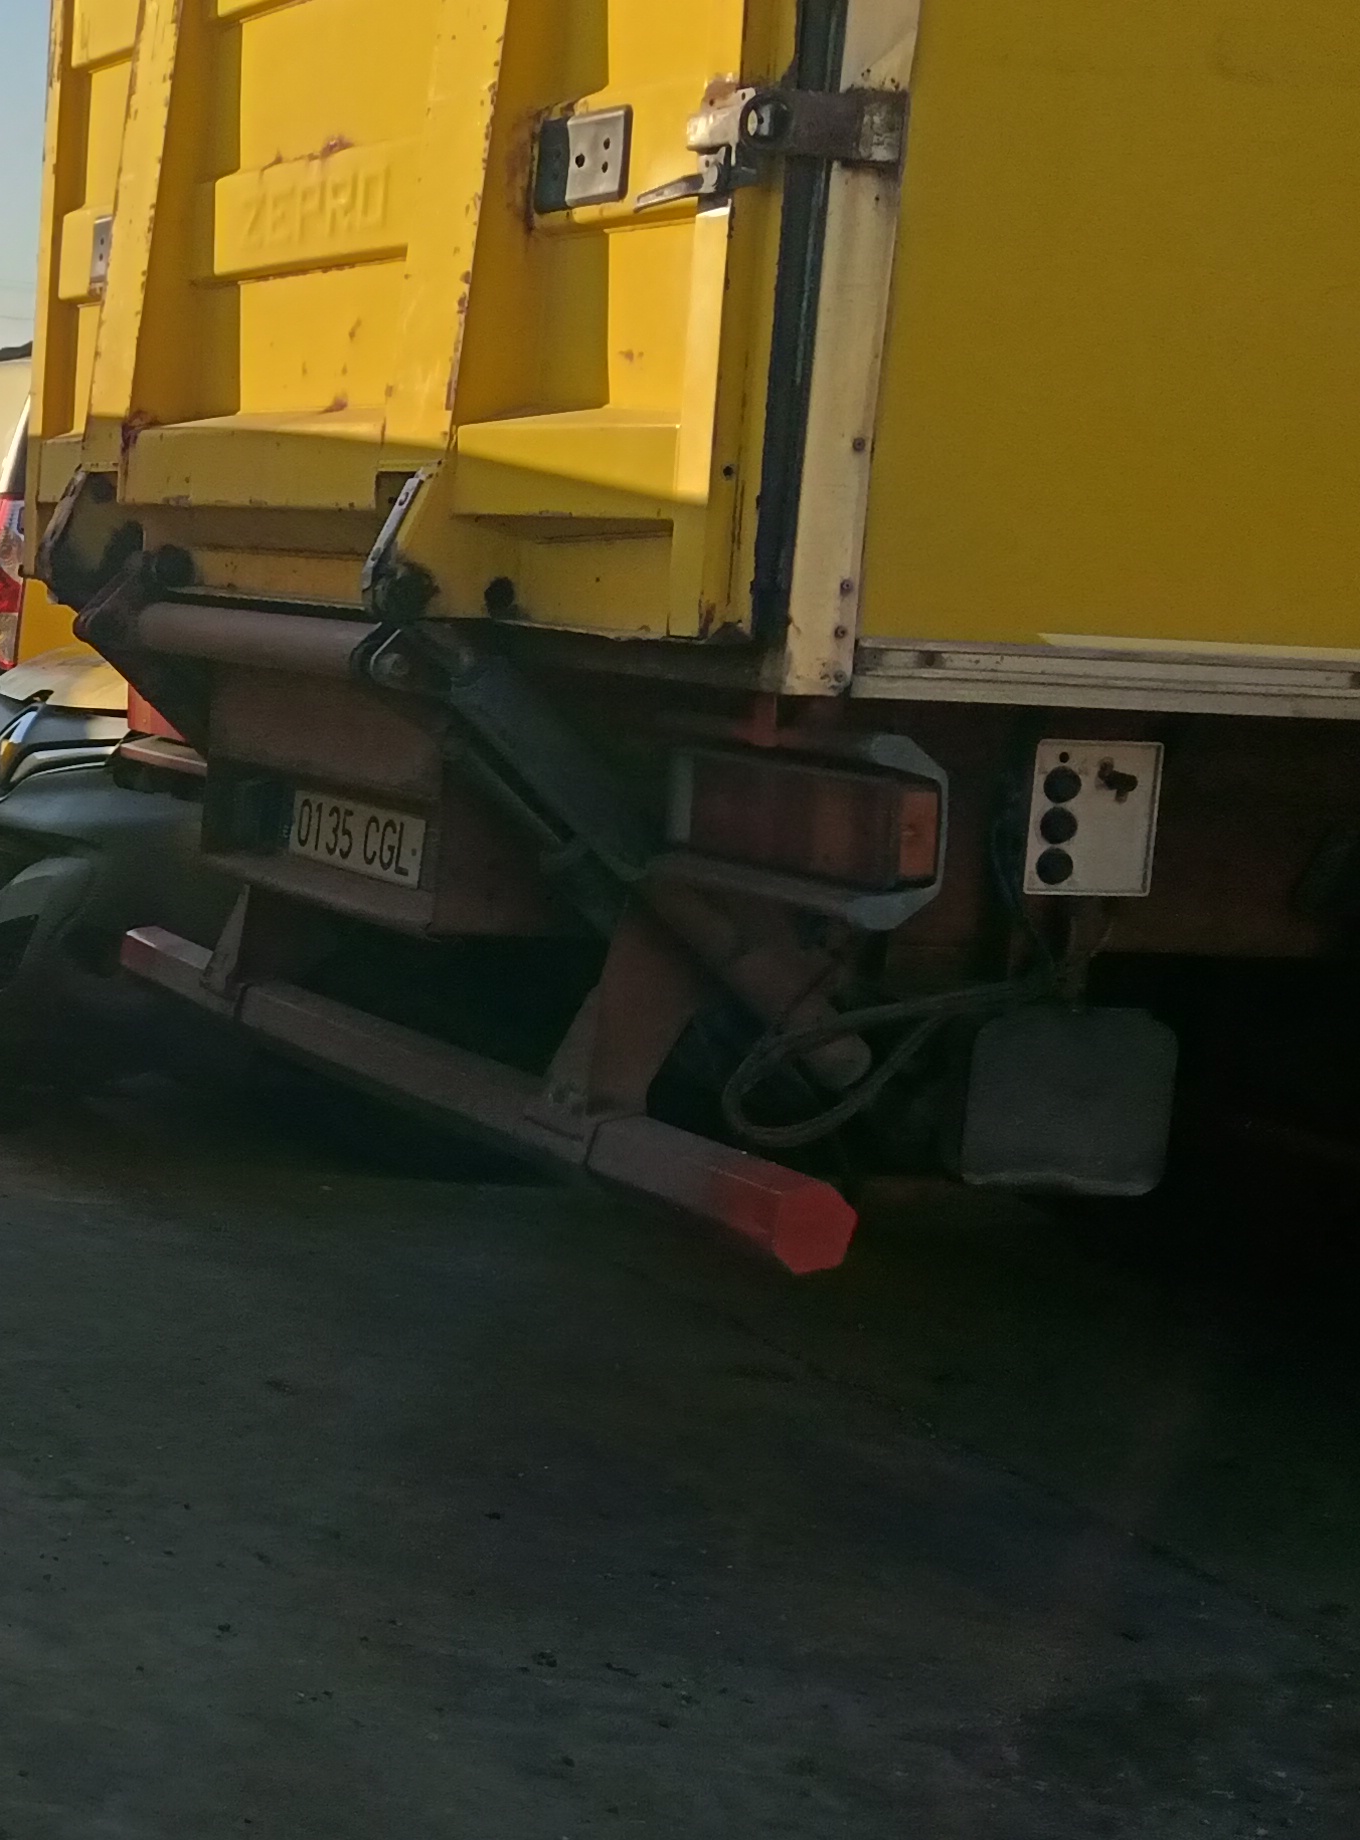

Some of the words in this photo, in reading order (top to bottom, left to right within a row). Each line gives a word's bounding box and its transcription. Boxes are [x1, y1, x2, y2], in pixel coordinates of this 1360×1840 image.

[242, 166, 391, 250] ZEPRO
[297, 798, 354, 860] 0135
[363, 815, 409, 877] CGL
